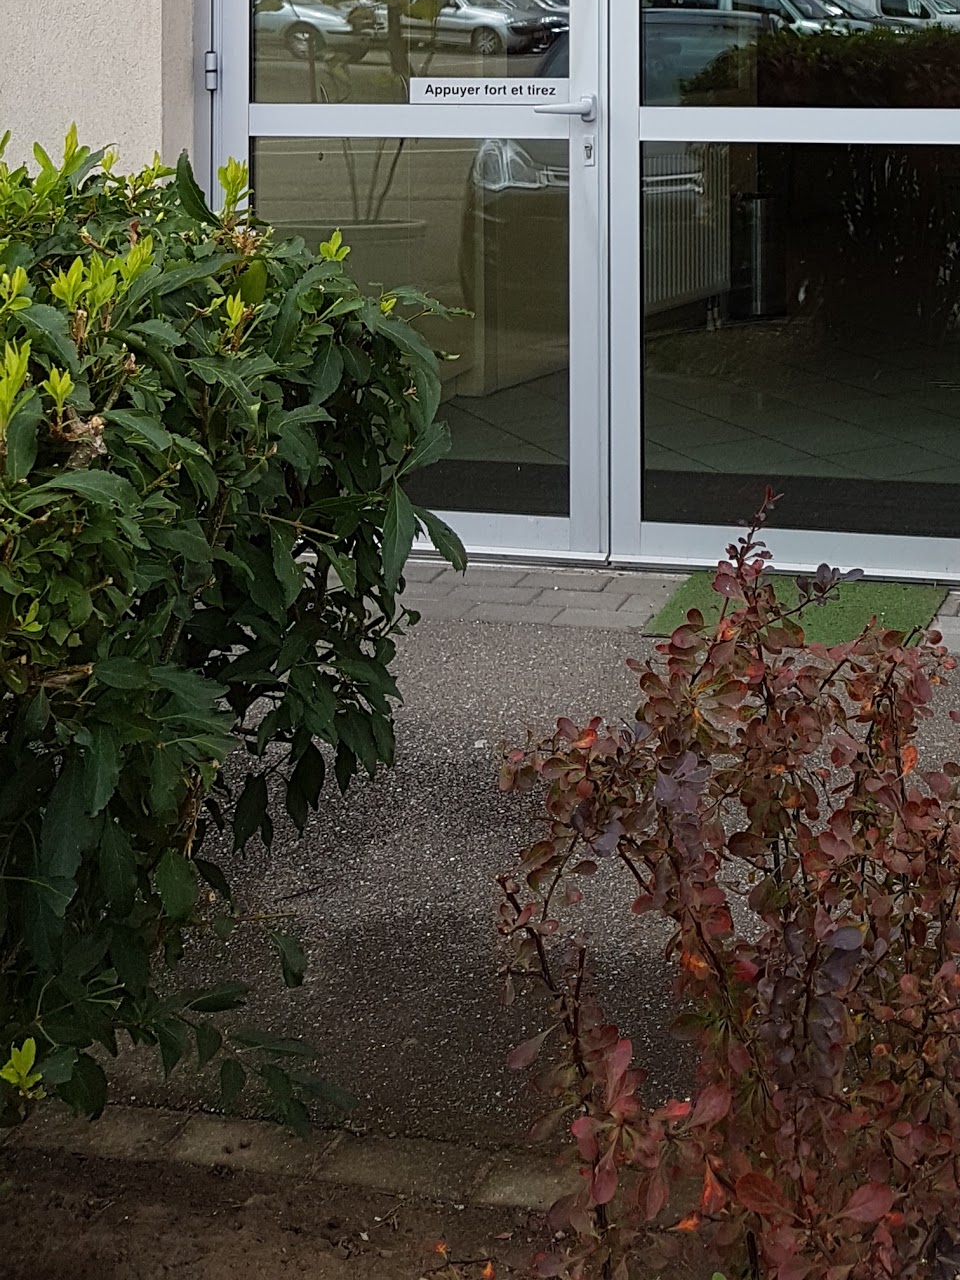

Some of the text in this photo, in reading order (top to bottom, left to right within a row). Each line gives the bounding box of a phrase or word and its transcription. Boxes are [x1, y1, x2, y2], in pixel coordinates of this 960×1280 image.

[425, 84, 556, 97] Appuyer fort et tirez
